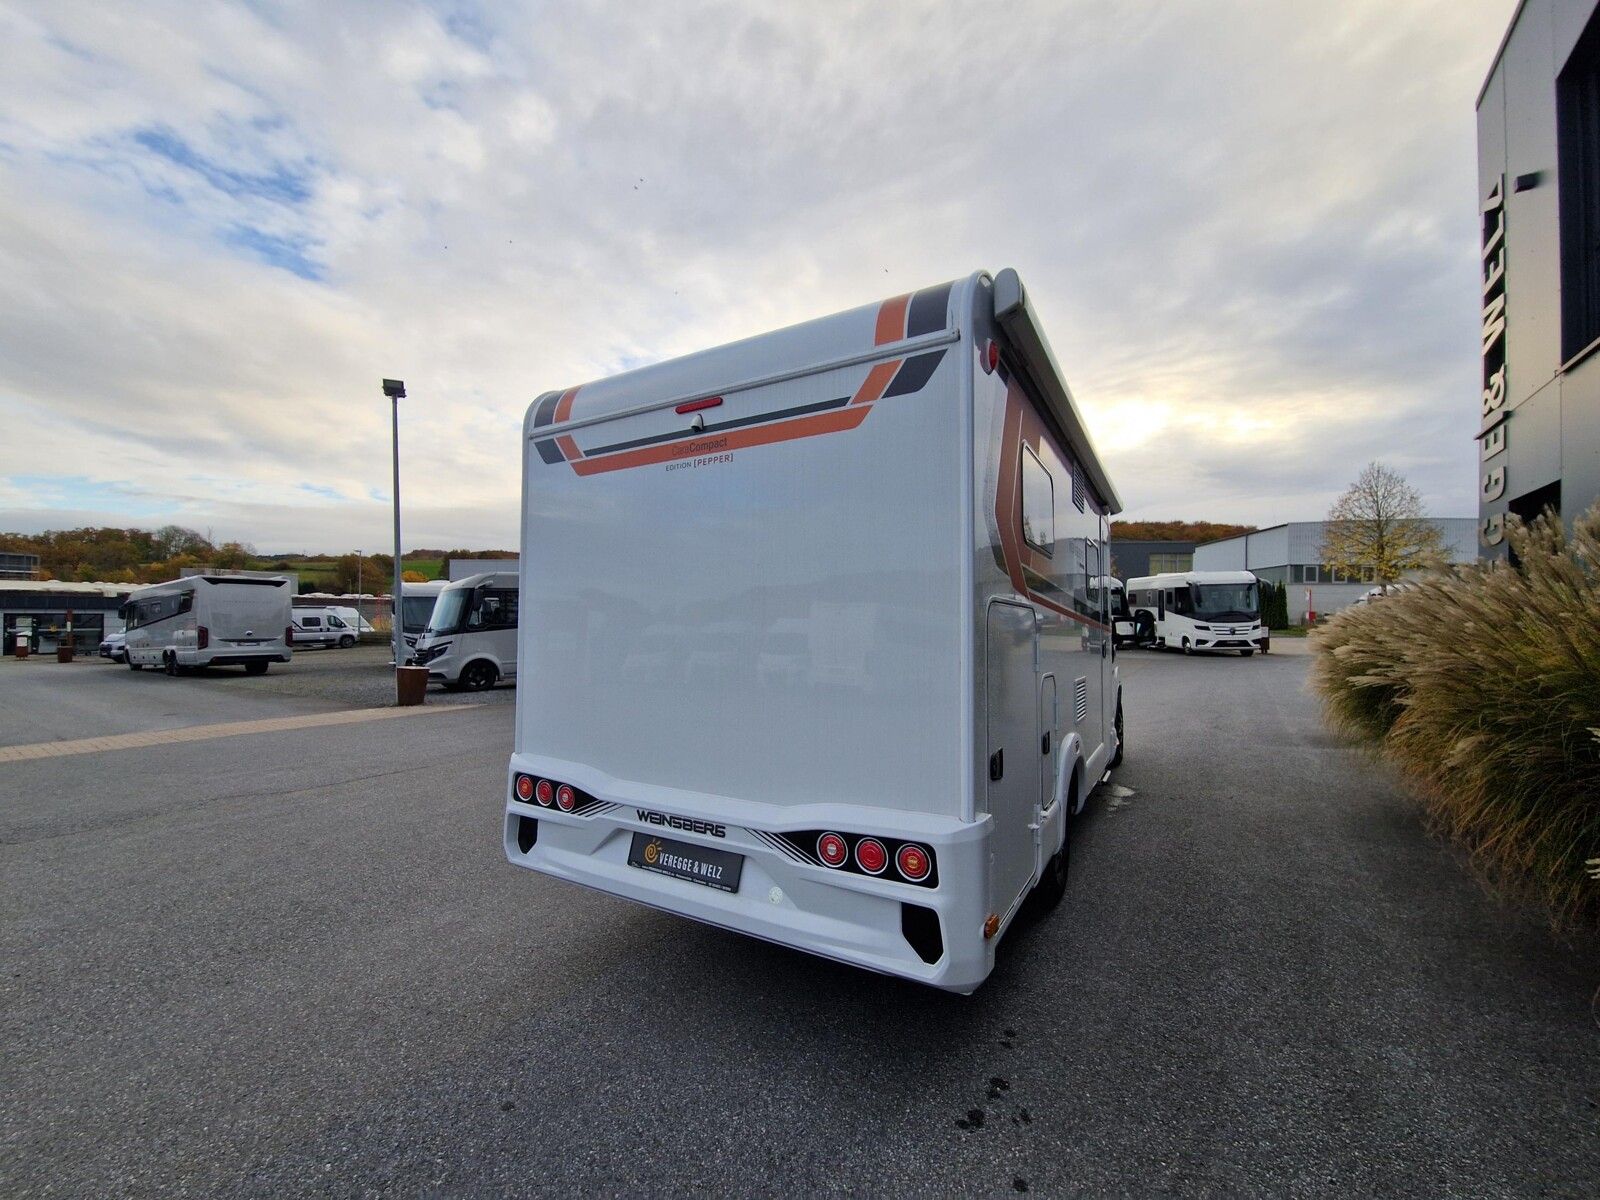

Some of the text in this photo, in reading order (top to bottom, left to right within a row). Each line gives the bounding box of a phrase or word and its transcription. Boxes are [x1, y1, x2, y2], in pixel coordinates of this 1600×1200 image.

[1481, 363, 1506, 414] &
[665, 461, 692, 471] EDITION
[1480, 423, 1506, 569] GGE
[636, 809, 726, 838] WEINSBERG
[659, 852, 692, 872] VEREGGE
[693, 861, 699, 873] &
[700, 862, 723, 880] WELZ
